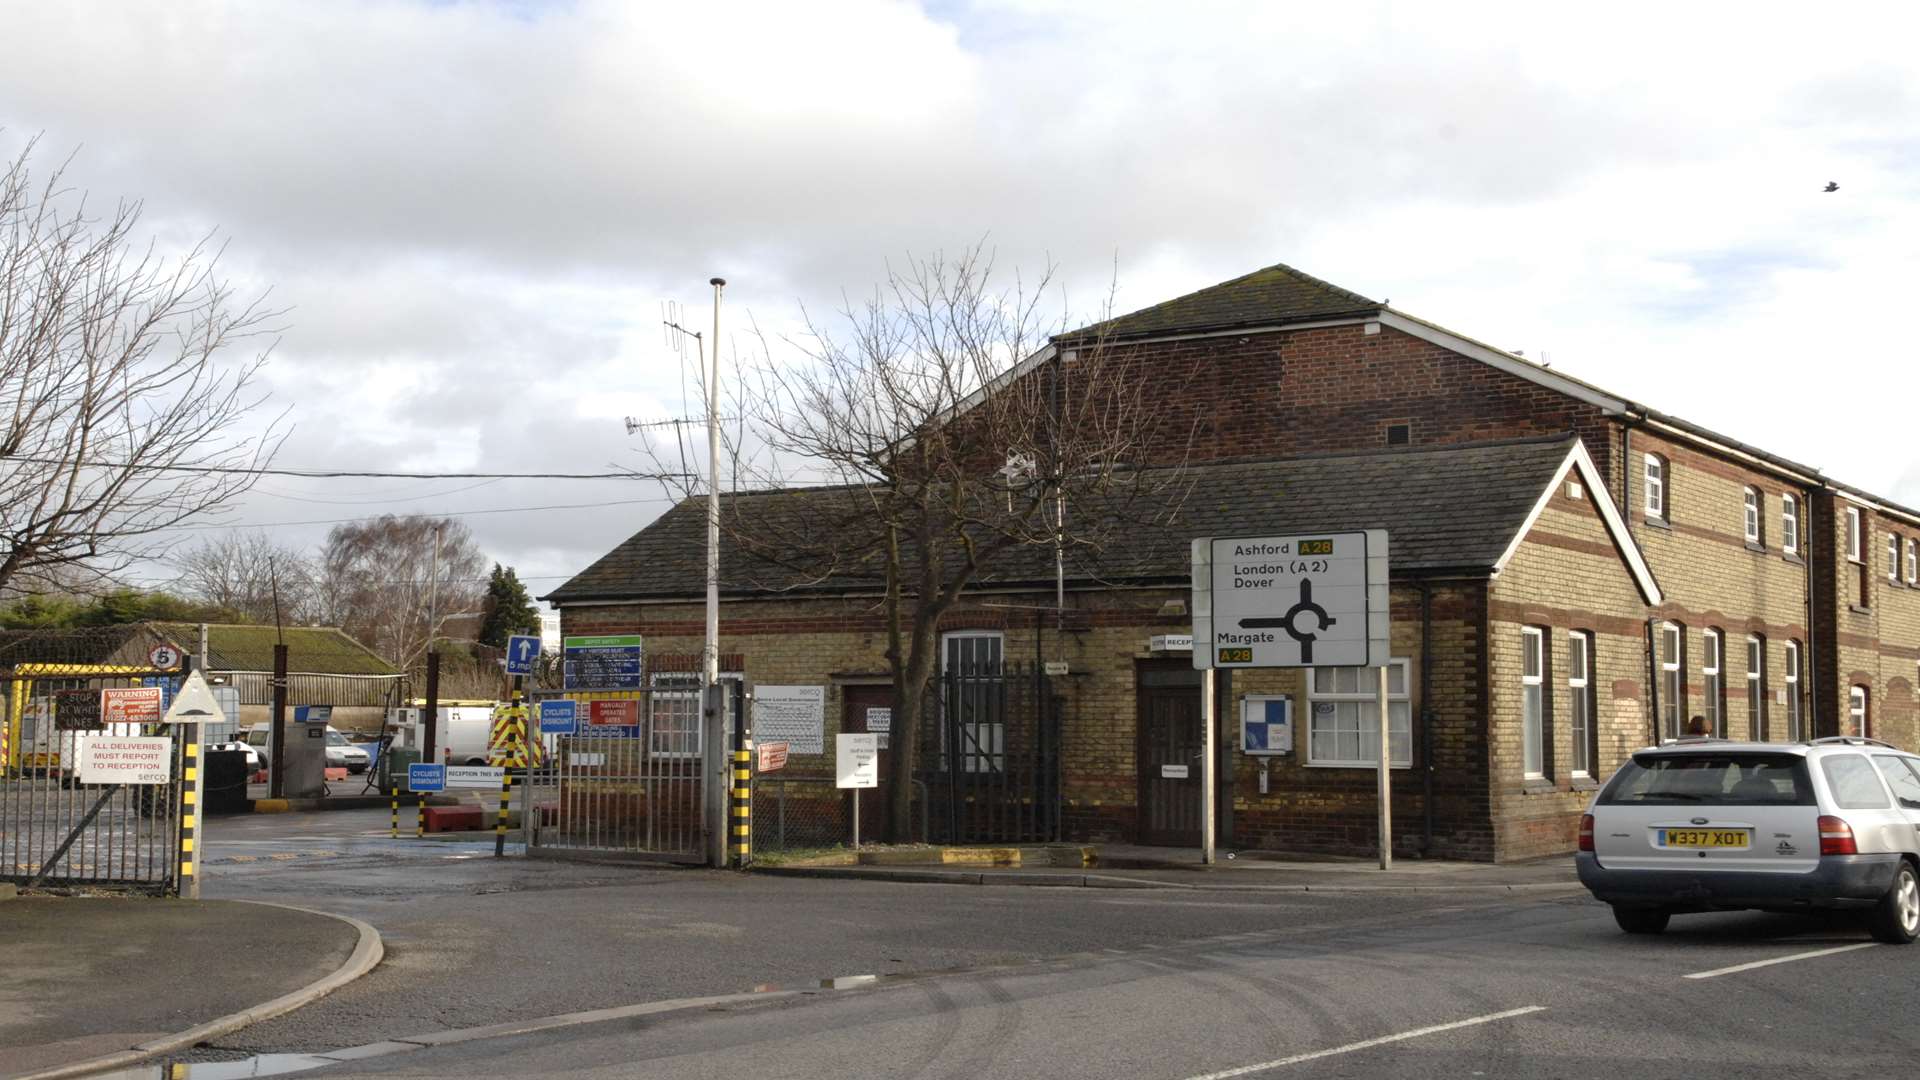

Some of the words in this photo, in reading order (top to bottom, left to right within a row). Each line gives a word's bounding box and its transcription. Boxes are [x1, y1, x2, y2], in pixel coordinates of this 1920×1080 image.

[1234, 543, 1290, 556] Ashford
[1300, 541, 1332, 553] A28
[1234, 563, 1284, 575] London
[1234, 577, 1274, 588] Dover
[1217, 632, 1275, 645] Margate
[158, 649, 169, 664] 5
[1220, 650, 1251, 662] A28
[509, 660, 516, 669] 5
[107, 689, 158, 698] WARNING
[543, 708, 572, 717] CYCLISTS
[542, 717, 573, 726] DISMOUNT
[110, 743, 164, 751] DELIVERIES
[138, 773, 168, 782] serco
[412, 770, 441, 778] CYCLISTS
[411, 777, 441, 785] DISMOUNT
[1668, 831, 1708, 844] W337
[1713, 832, 1745, 845] XOT
